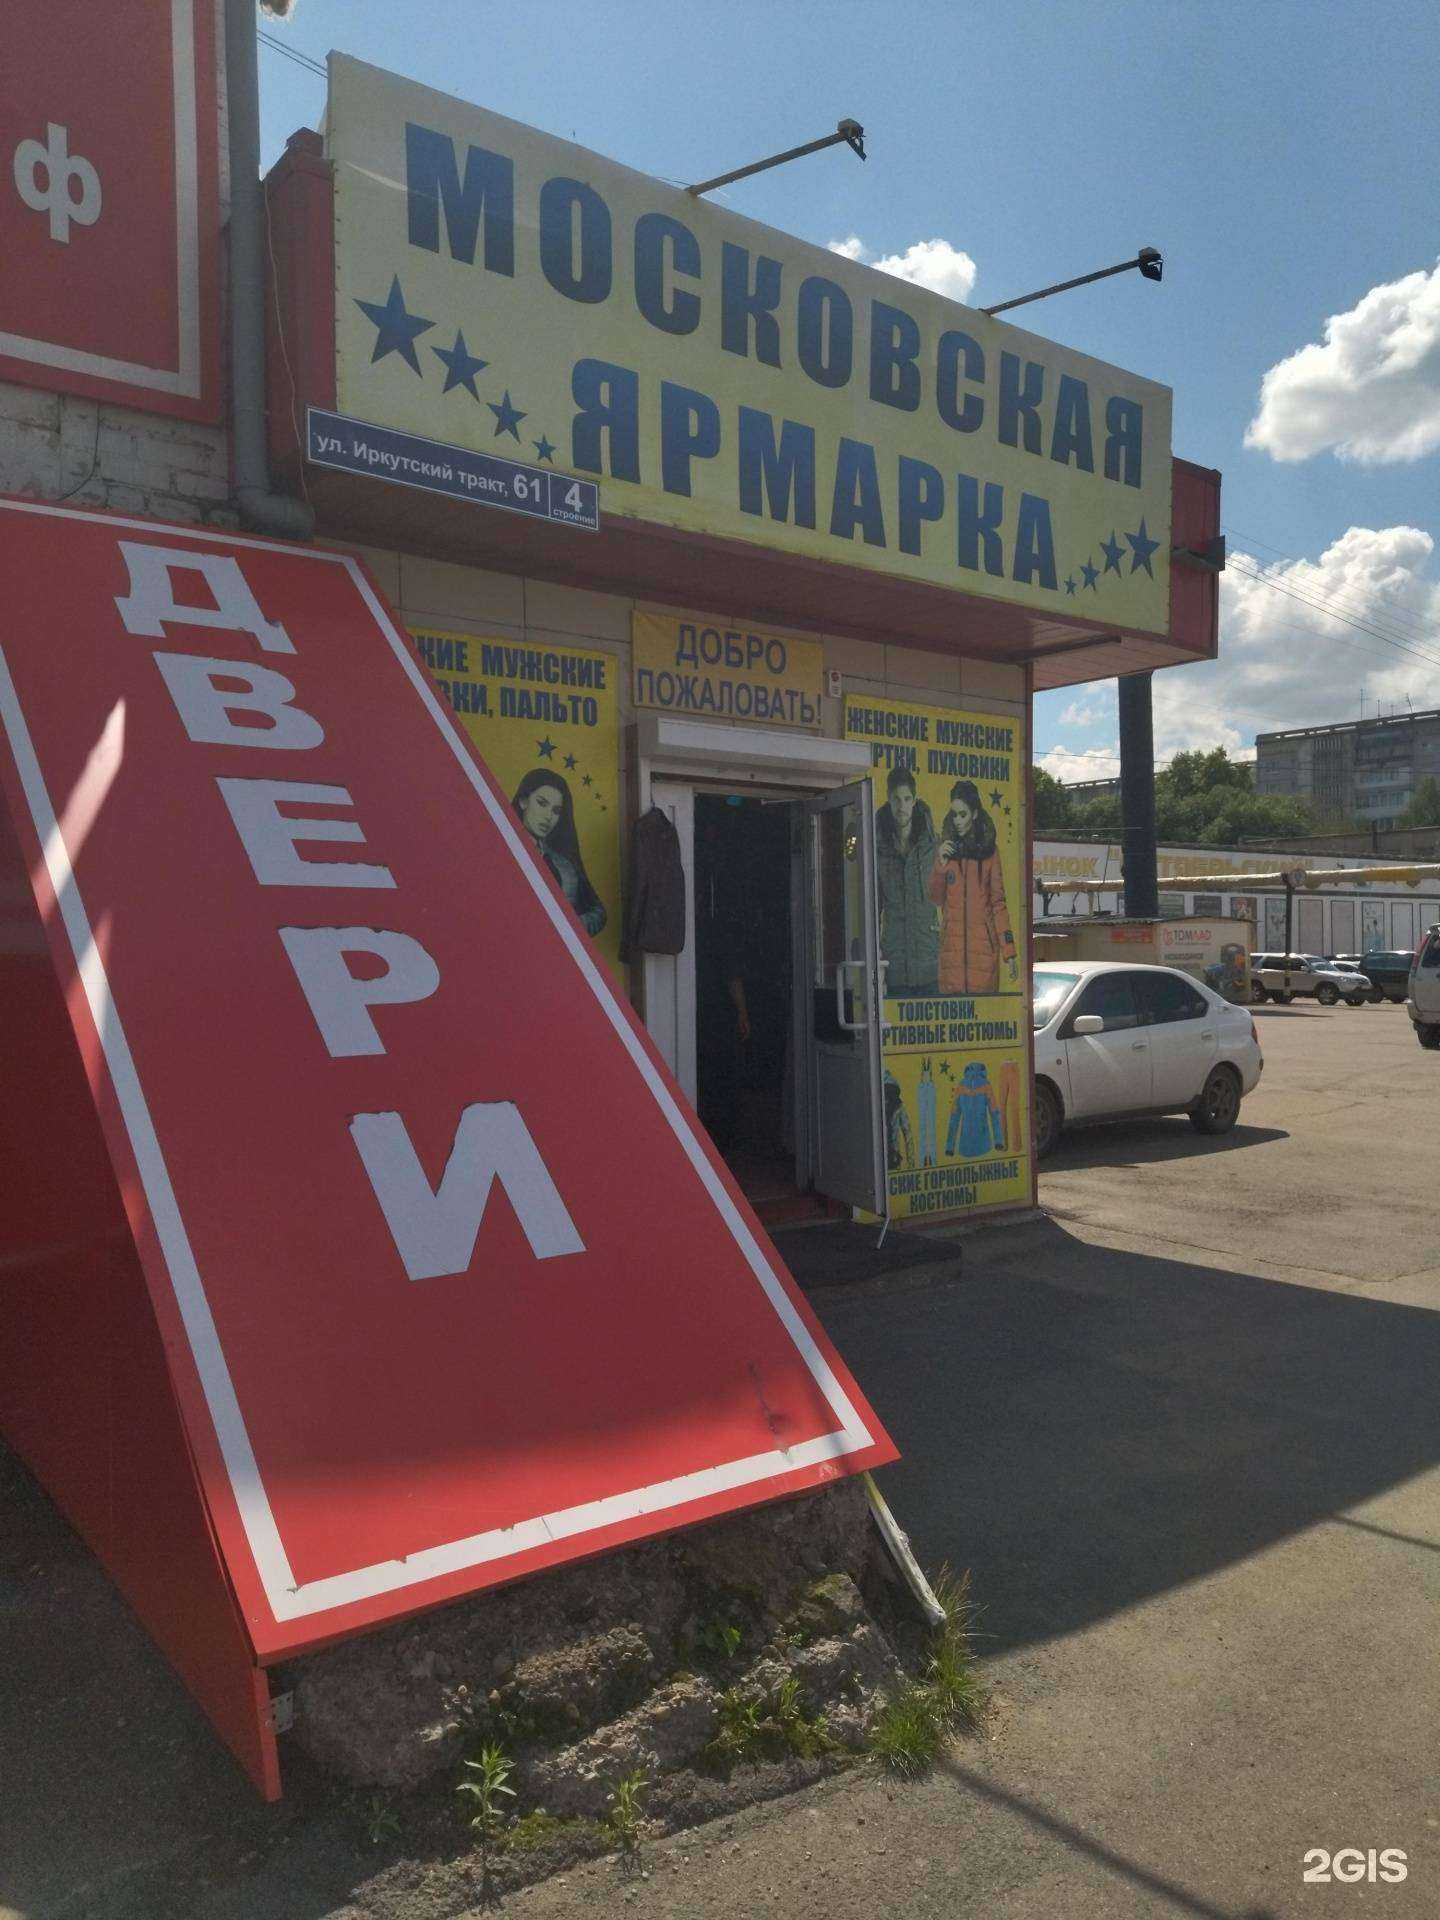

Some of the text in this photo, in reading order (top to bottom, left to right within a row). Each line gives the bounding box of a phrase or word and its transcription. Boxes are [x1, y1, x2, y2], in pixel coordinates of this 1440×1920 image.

[405, 121, 1143, 488] МОСКОВСКАЯ
[316, 433, 541, 502] ул. Иркутский тракт, 61
[571, 357, 1058, 591] ЯРМАРКА
[553, 508, 596, 526] строение
[564, 483, 583, 512] 4
[410, 634, 606, 690] КИЕ МУЖСКИЕ
[676, 623, 787, 675] ДОБРО
[500, 684, 599, 727] ПАЛЬТО
[637, 668, 822, 724] ПОЖАЛОВАТЬ!
[848, 706, 1013, 752] ЖЕНСКИЕ МУЖСКИЕ
[927, 748, 1010, 781] ПУХОВИКИ
[113, 540, 587, 1281] ДВЕРИ
[897, 1000, 978, 1021] ТОЛСТОВКИ,
[882, 1021, 1018, 1046] РТИВНЫЕ КОСТЮМЫ
[889, 1160, 1019, 1195] СКИЕ ГОРНОЛЫЖНЫЕ
[910, 1185, 977, 1213] КОСТЮМЫ
